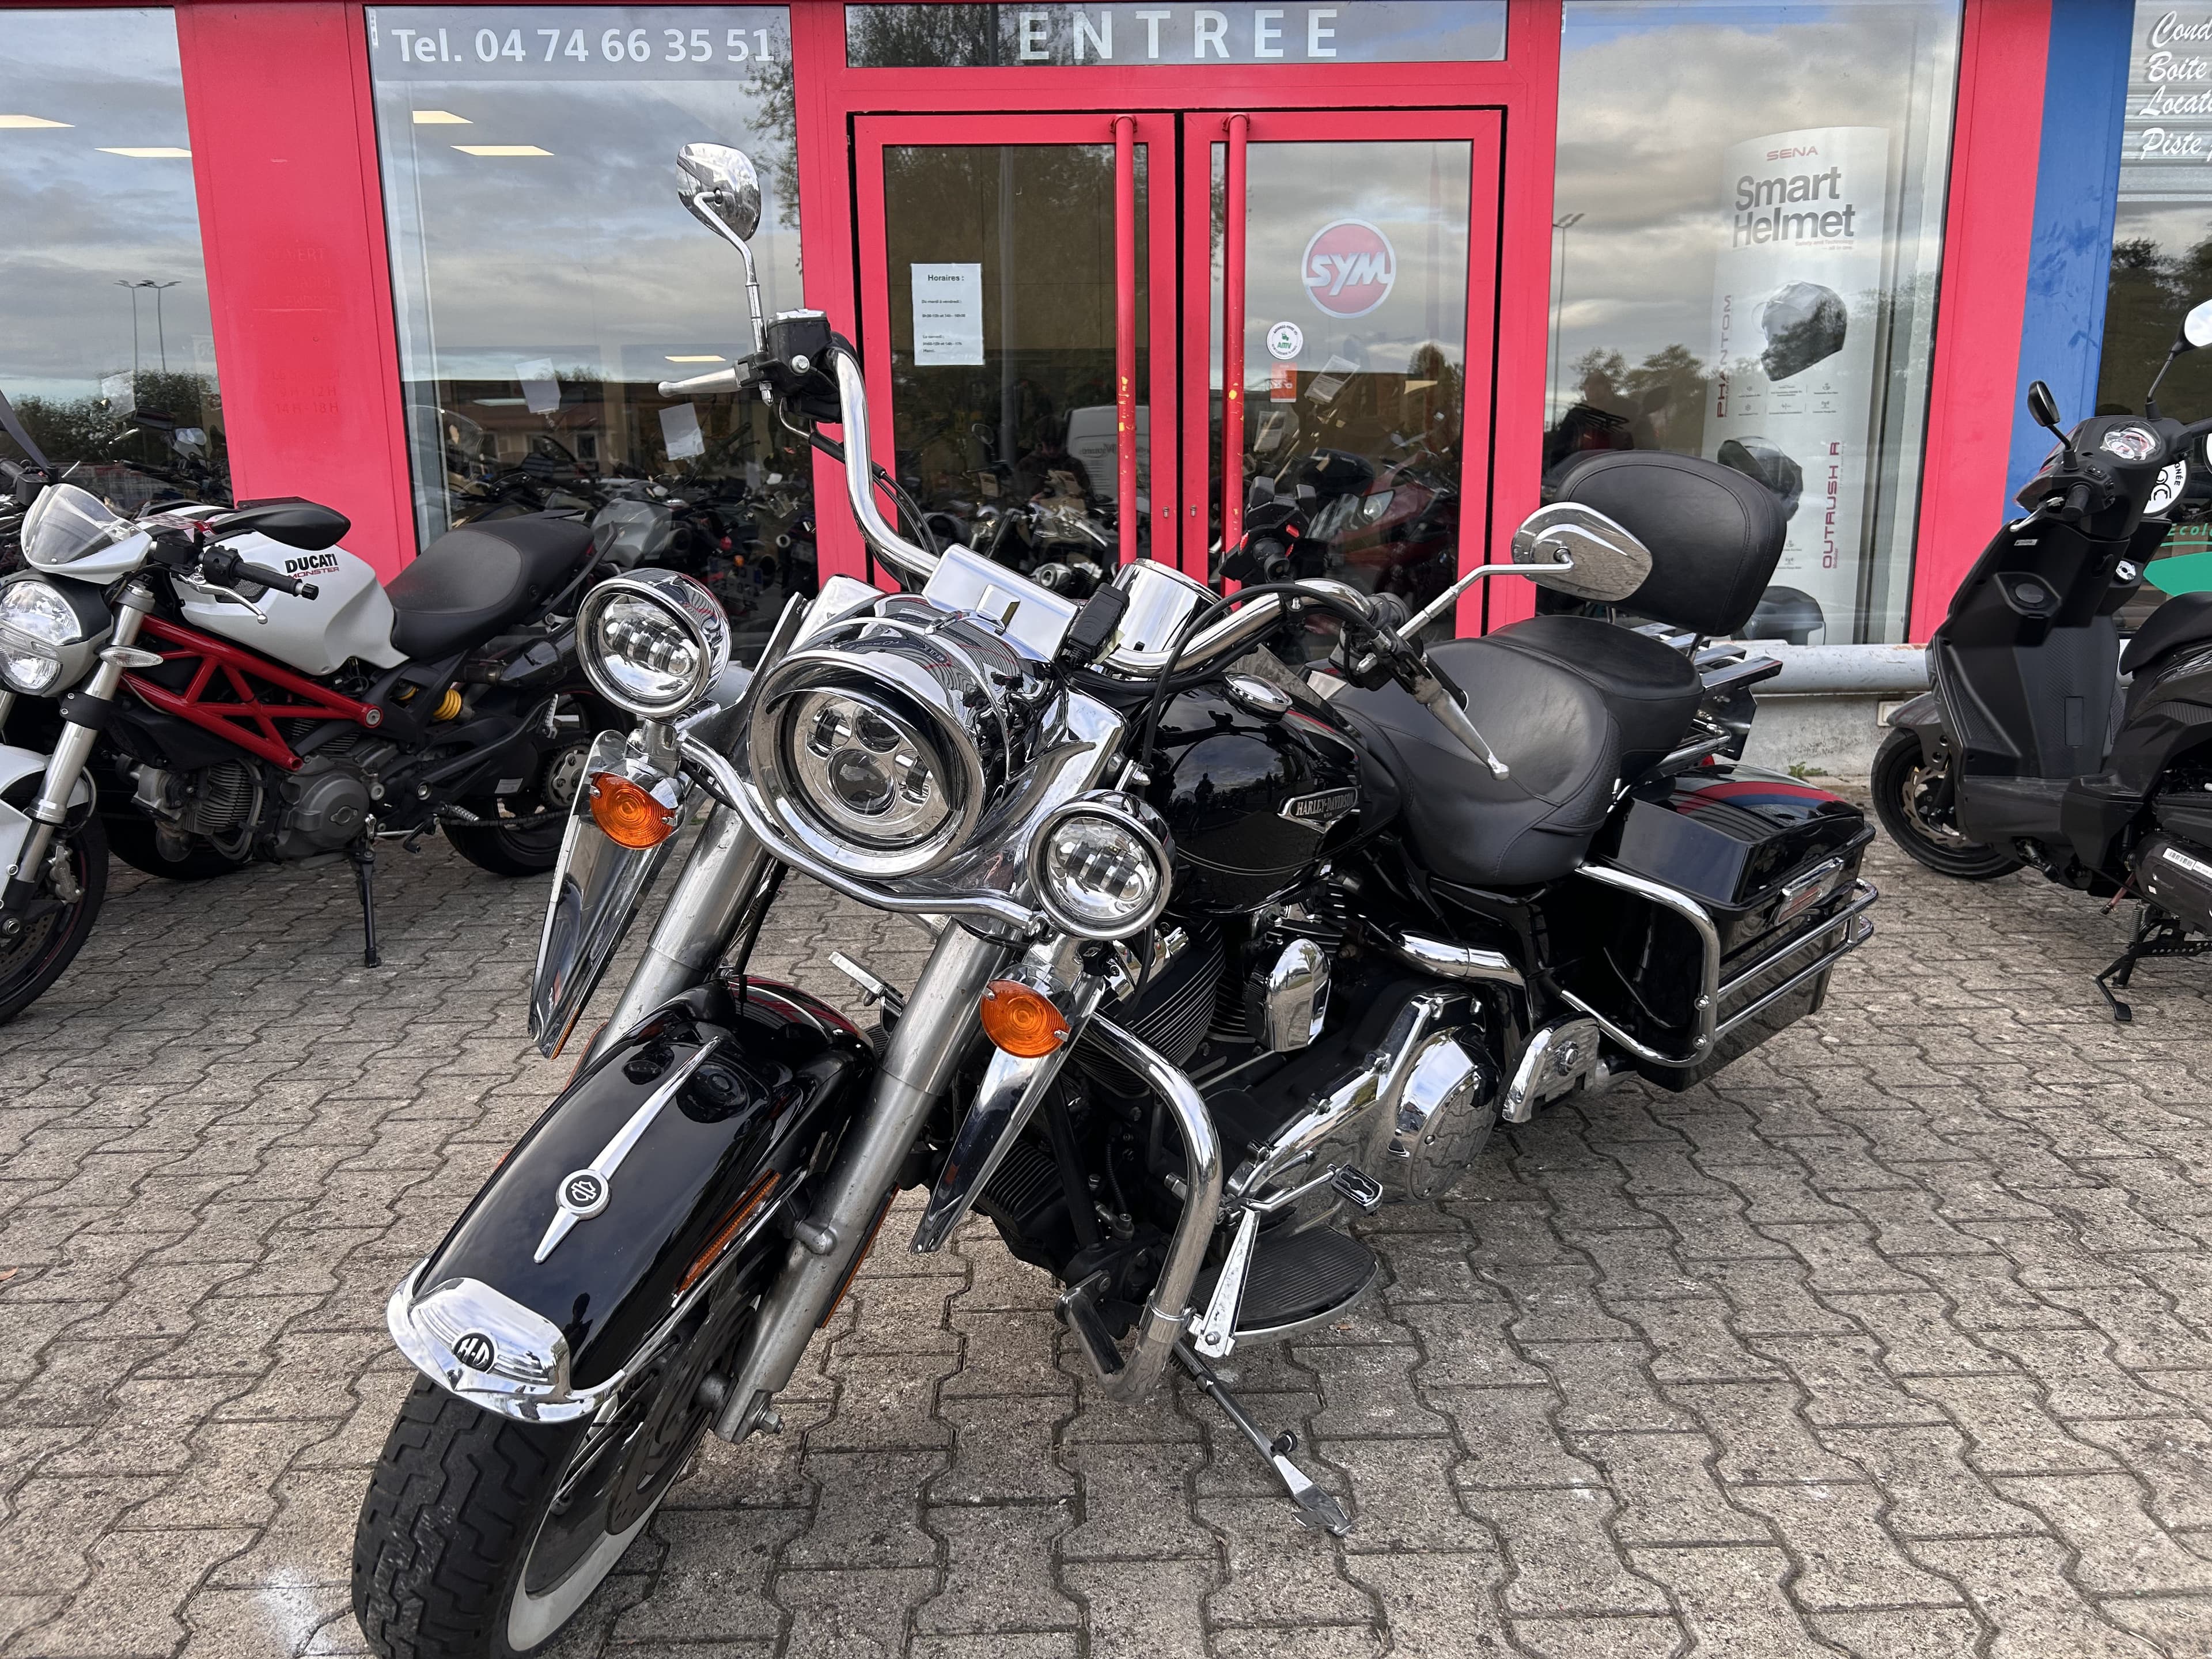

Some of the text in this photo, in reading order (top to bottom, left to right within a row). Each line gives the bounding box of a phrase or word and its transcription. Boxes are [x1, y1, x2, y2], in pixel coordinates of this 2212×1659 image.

[392, 28, 774, 62] Tel. 04 74 66 35 51
[1019, 9, 1338, 60] ENTREE
[2148, 51, 2207, 82] Boite
[1766, 146, 1819, 161] SENA
[2140, 127, 2202, 160] Piste
[1736, 166, 1842, 211] Smart
[1733, 204, 1855, 247] Helmet
[1306, 252, 1392, 297] SYM
[285, 553, 338, 573] DUCATI
[1296, 792, 1355, 816] HARLEY-DAVIDSON
